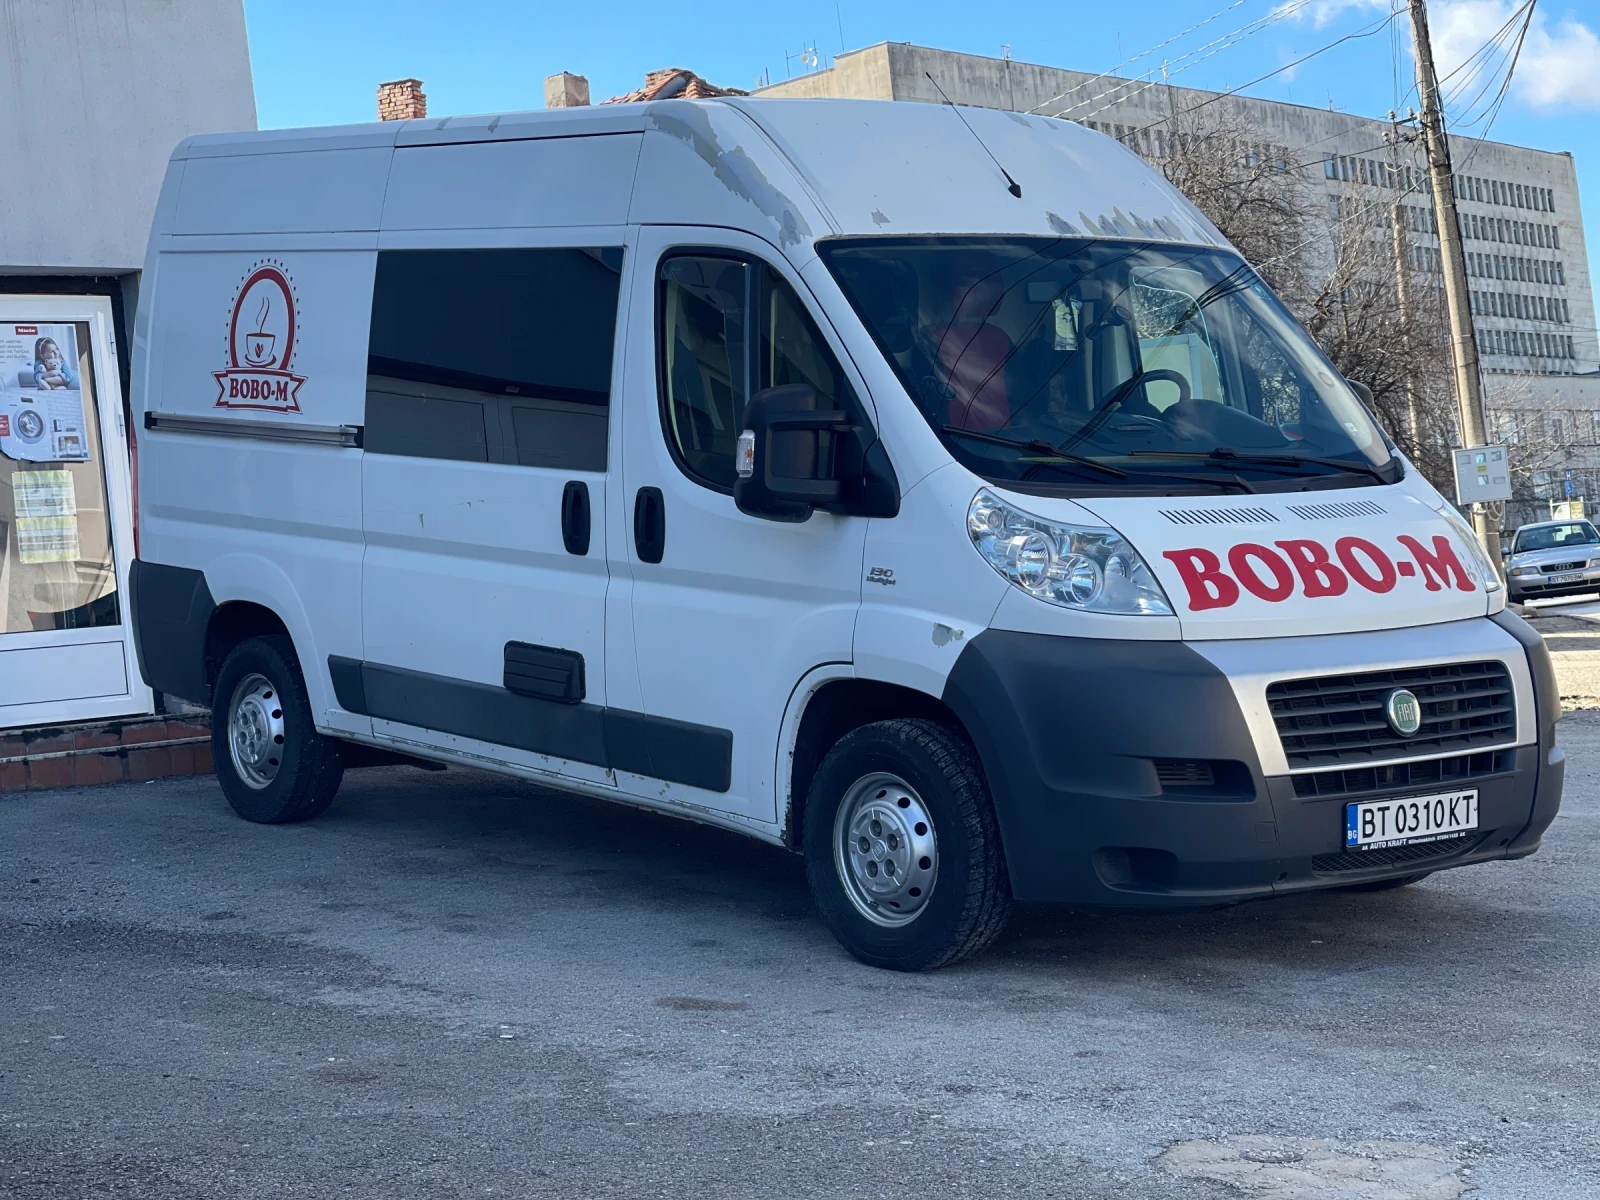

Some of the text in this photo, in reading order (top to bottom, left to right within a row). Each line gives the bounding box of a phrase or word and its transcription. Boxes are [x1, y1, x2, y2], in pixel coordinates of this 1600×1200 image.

[229, 378, 289, 401] BOBO-M
[870, 566, 893, 577] 130
[1162, 534, 1477, 612] BOBO-M
[1397, 702, 1415, 722] FIAT
[1362, 794, 1475, 838] BT 0310 KT
[1347, 829, 1358, 840] BG
[1369, 841, 1387, 850] AUTO
[1387, 838, 1407, 848] KRAFT
